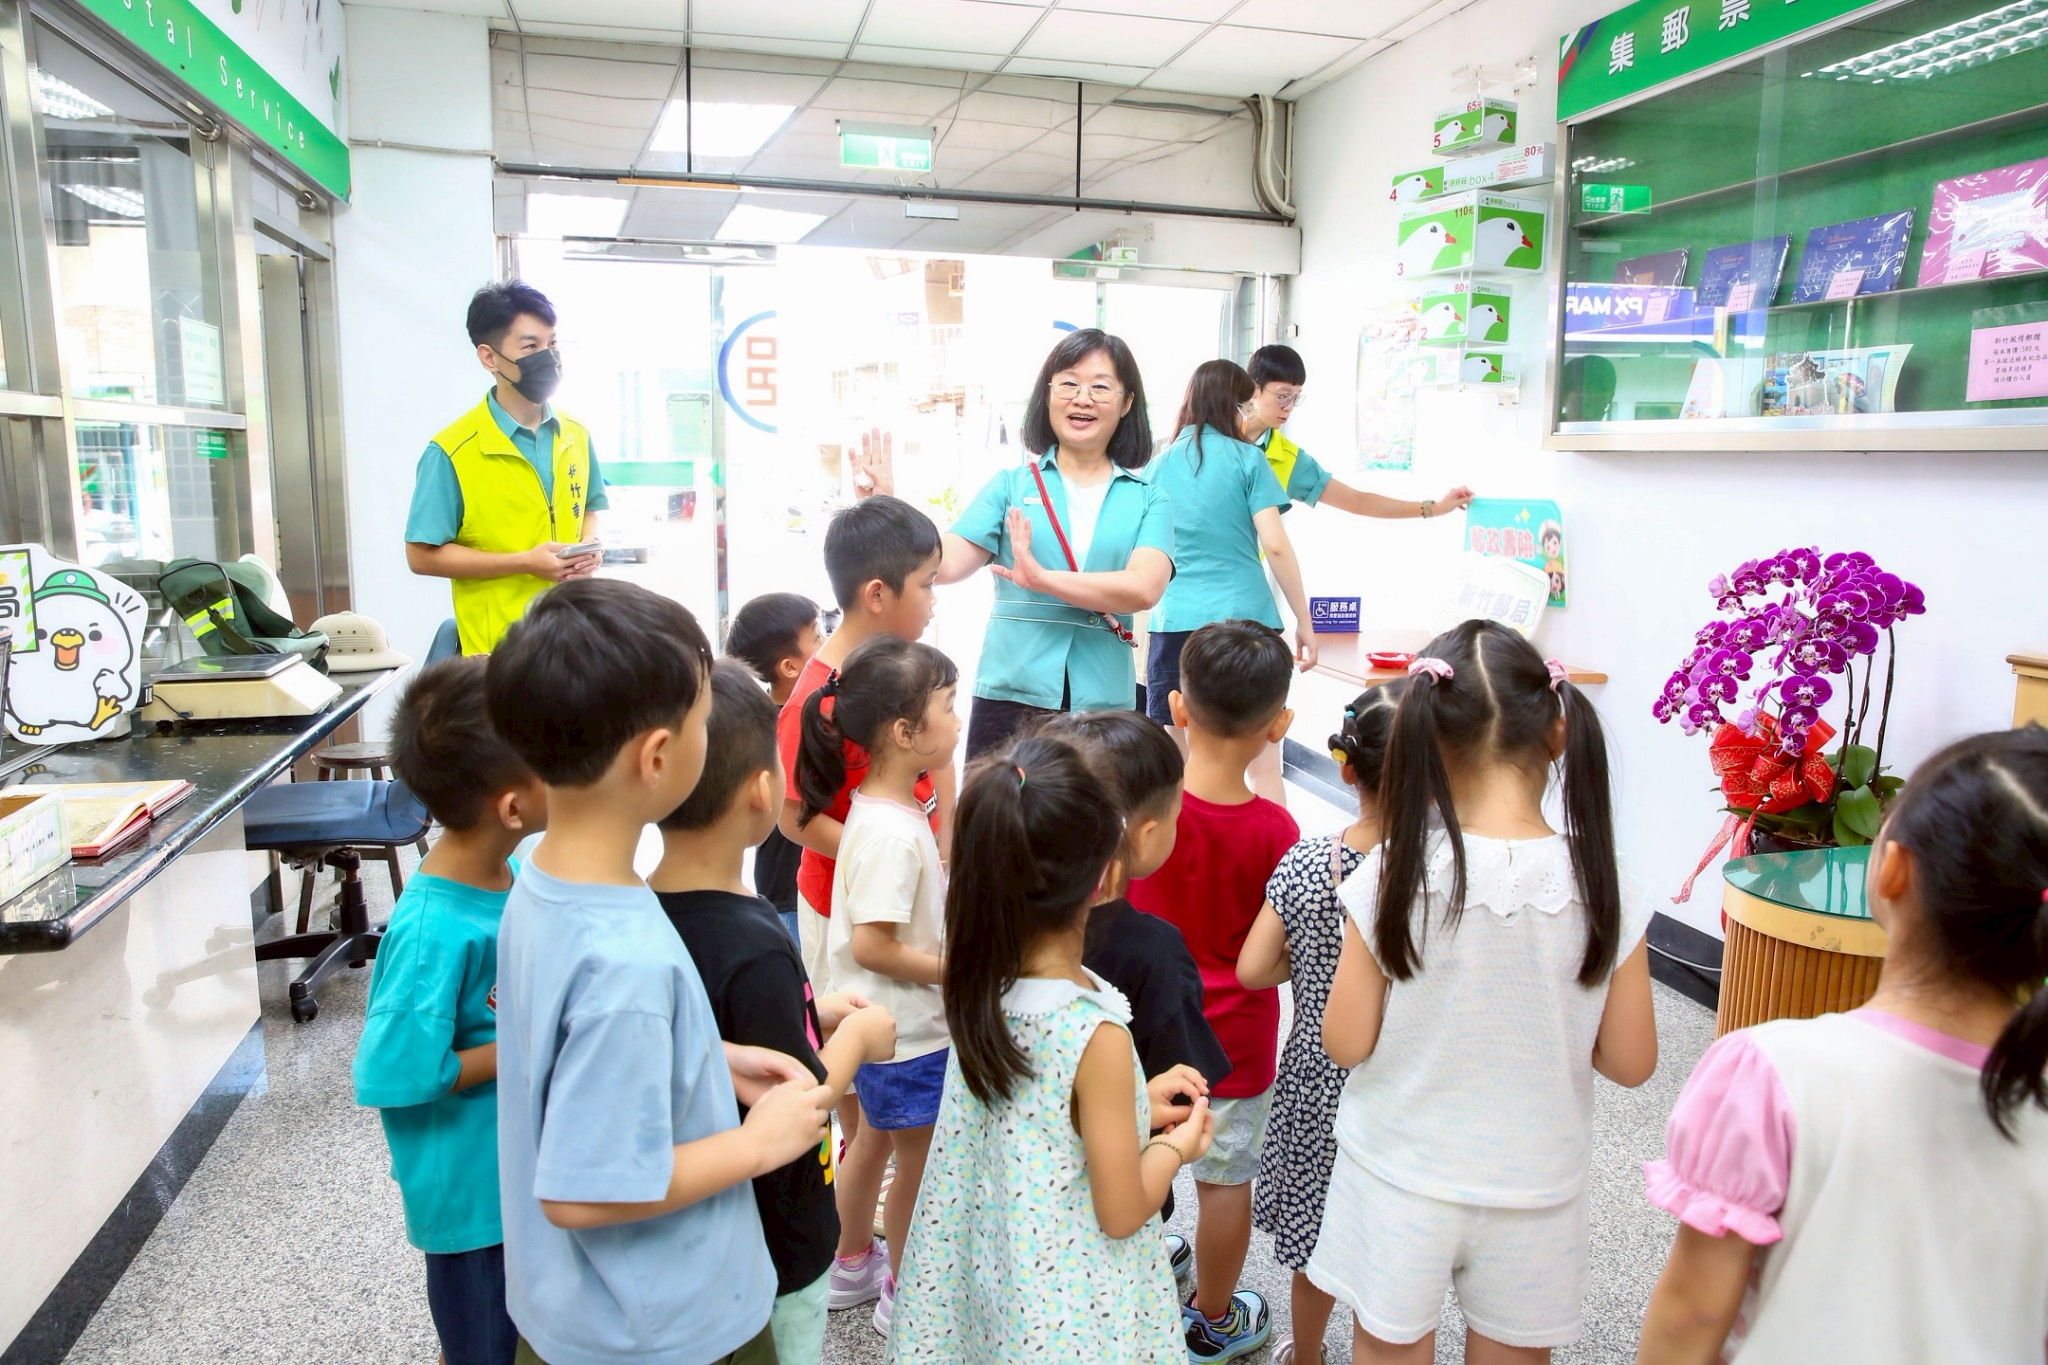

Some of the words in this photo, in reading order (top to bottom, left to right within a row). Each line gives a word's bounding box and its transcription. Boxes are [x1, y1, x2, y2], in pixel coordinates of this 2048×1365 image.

[1608, 0, 1797, 76] 集郵票
[219, 55, 305, 150] Service
[1466, 101, 1483, 113] 65元
[1433, 134, 1441, 148] 5
[1524, 145, 1544, 158] 80元
[1469, 171, 1495, 185] box4
[1389, 188, 1398, 202] 4
[1454, 206, 1474, 218] 110元
[1397, 262, 1404, 276] 3
[1420, 327, 1428, 341] 2
[1459, 580, 1532, 625] 新竹郵局
